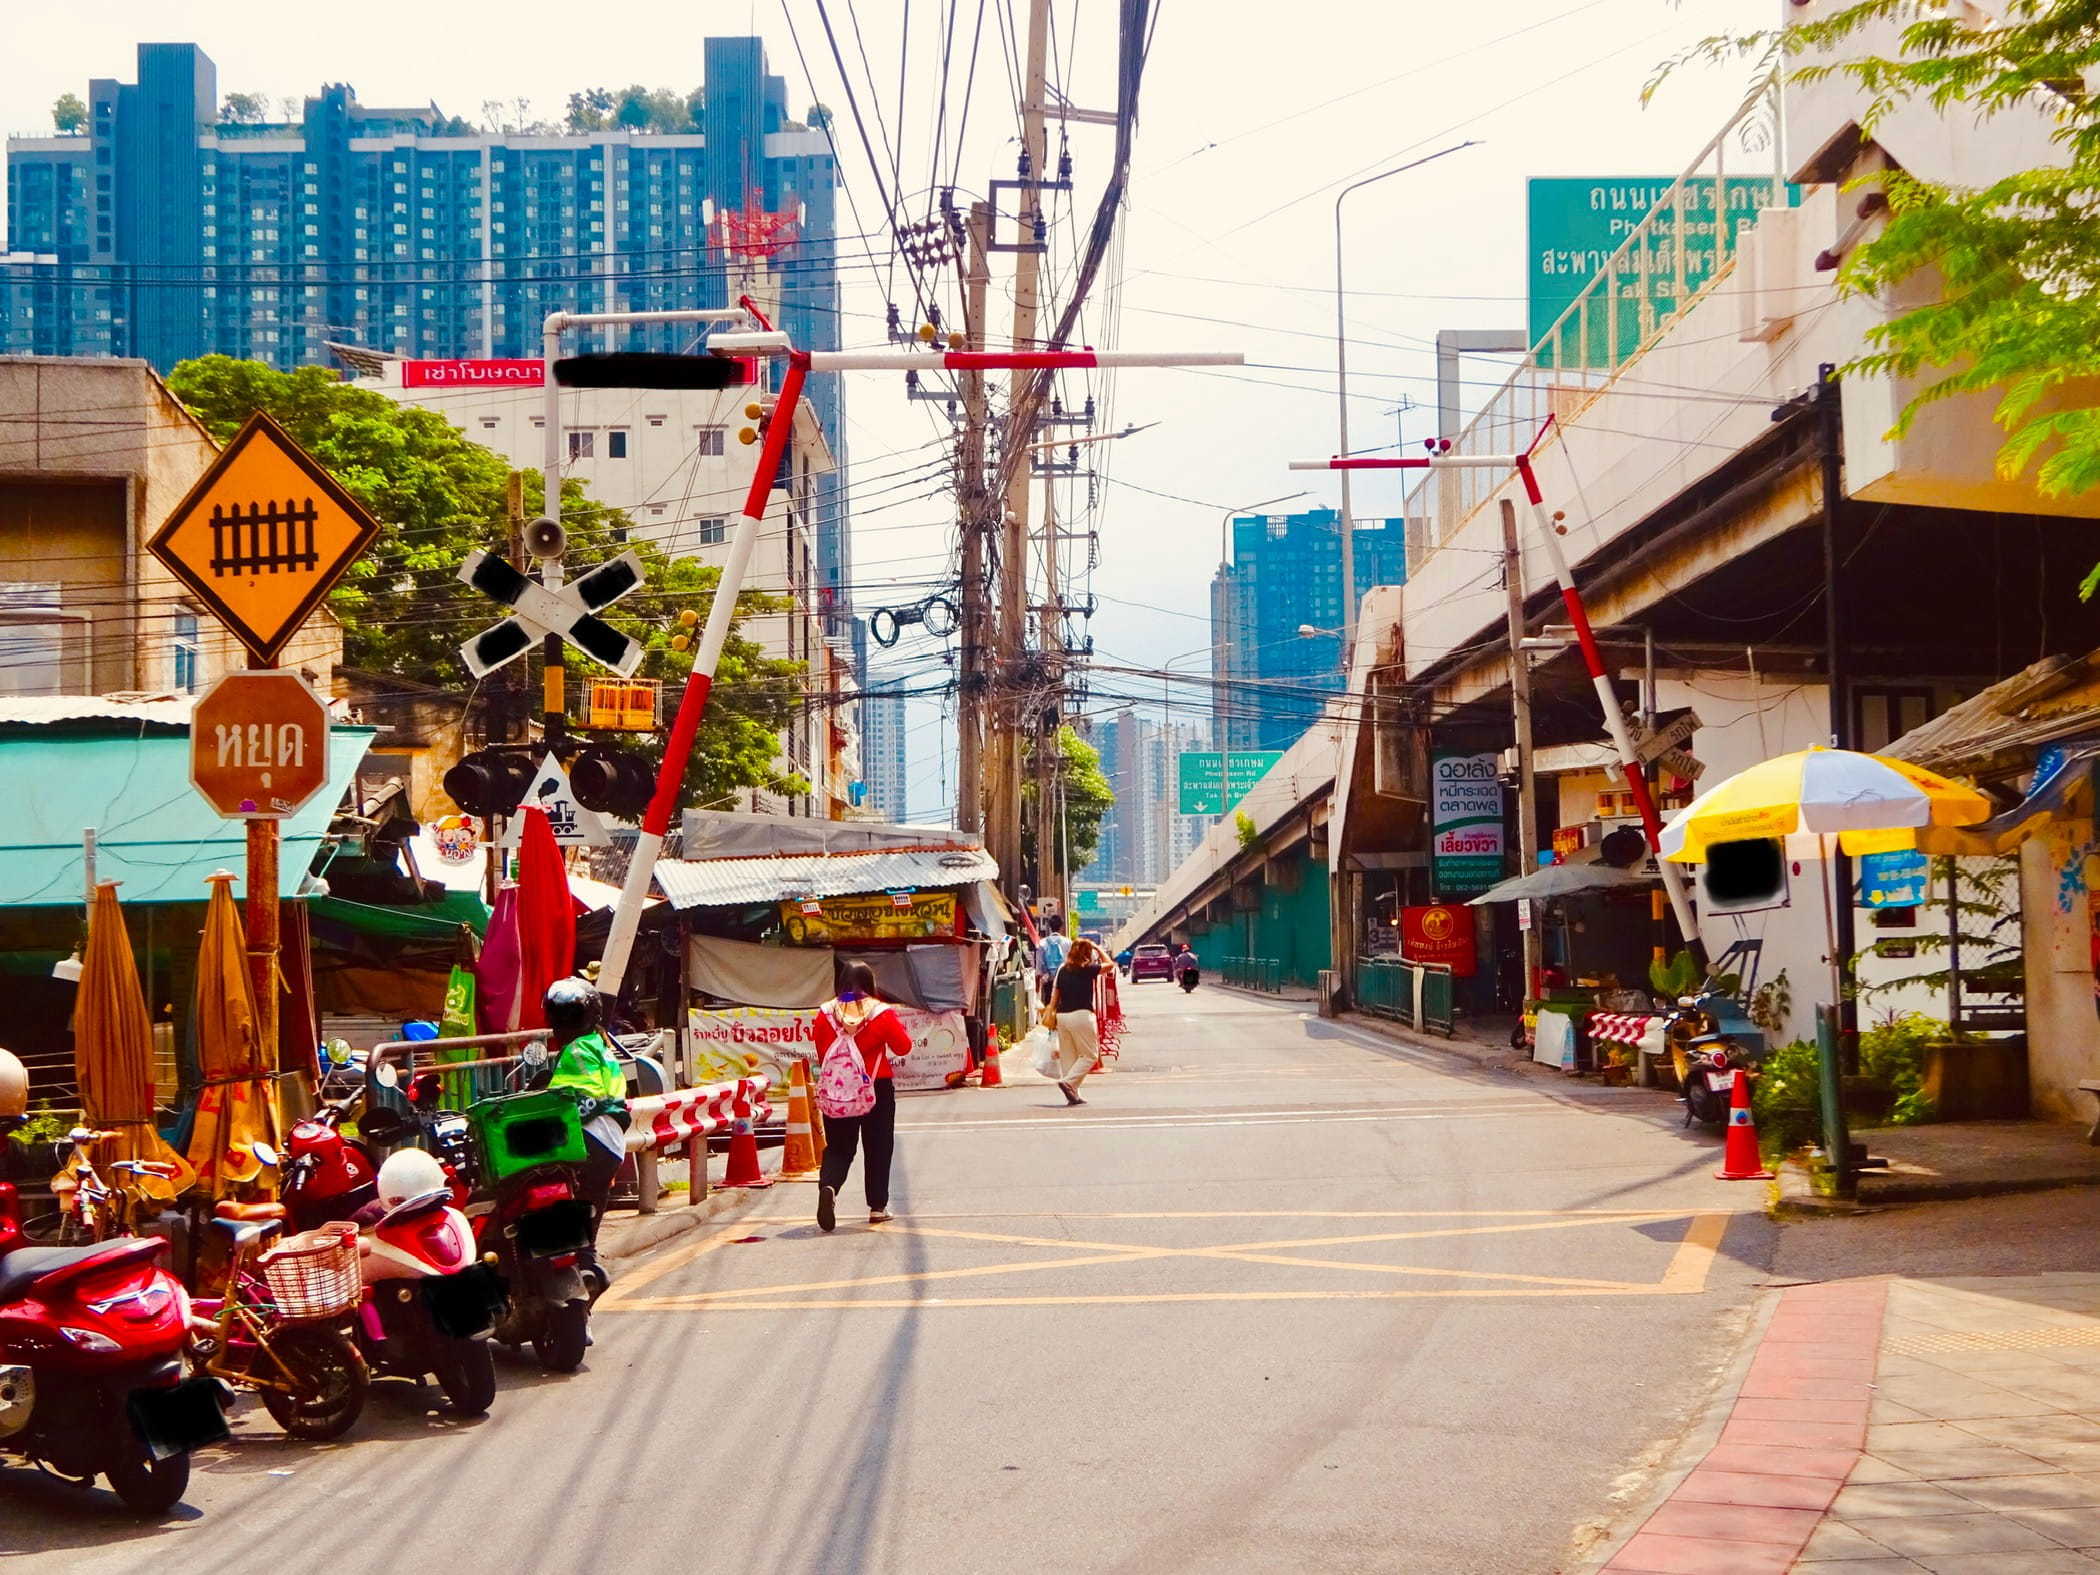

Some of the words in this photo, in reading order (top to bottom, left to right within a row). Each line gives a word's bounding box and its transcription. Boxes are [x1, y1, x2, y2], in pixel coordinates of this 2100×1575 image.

[214, 723, 304, 789] หยุด
[1439, 800, 1498, 814] ตลาดพลู
[1440, 830, 1498, 853] เลี้ยวขวา
